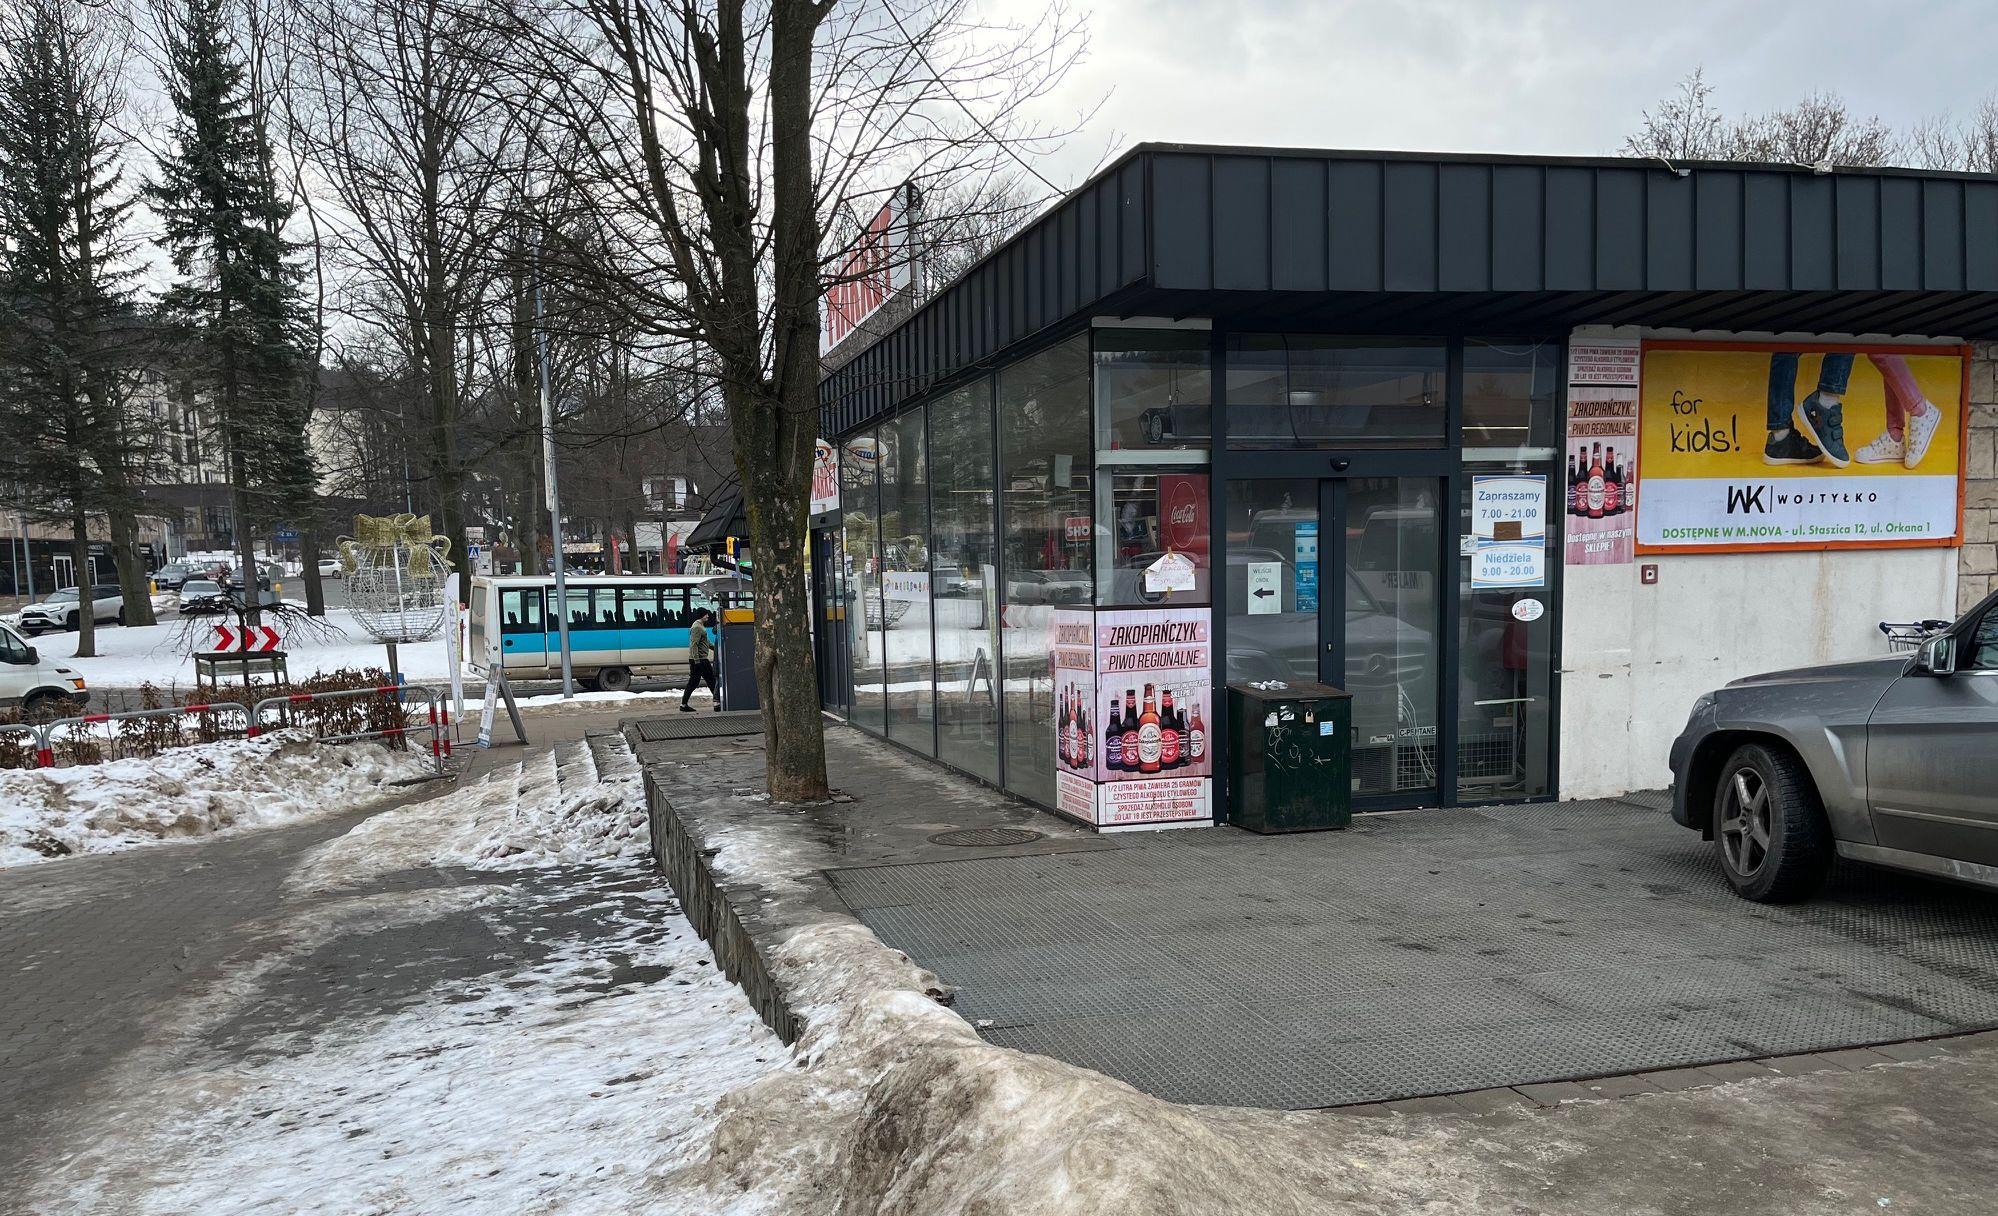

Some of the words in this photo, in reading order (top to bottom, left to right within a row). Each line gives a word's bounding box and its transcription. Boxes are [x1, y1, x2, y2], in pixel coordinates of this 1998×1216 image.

[1574, 398, 1632, 416] ZAKOPIAŃCZYK
[1670, 390, 1702, 414] for
[1572, 423, 1590, 434] PIWO
[1591, 422, 1632, 434] REGIONALNE
[1670, 414, 1740, 452] kids!
[1478, 491, 1540, 503] Zapraszamy
[1778, 493, 1877, 504] WOJTYŁKO
[1482, 510, 1501, 518] 7.00
[1511, 509, 1537, 518] 21.00
[1662, 528, 1719, 540] DOSTĘPNE
[1722, 528, 1733, 536] W
[1736, 526, 1782, 536] M.NOVA
[1792, 525, 1805, 535] ul.
[1809, 524, 1850, 535] Staszica
[1855, 524, 1867, 535] 12,
[1871, 523, 1882, 533] ul.
[1886, 522, 1922, 532] Orkana
[1486, 553, 1531, 563] Niedziela
[1482, 567, 1501, 576] 9.00
[1510, 566, 1534, 576] 20.00
[1110, 620, 1197, 645] ZAKOPIAŃCZYK
[1109, 654, 1135, 670] PIWO
[1137, 650, 1200, 669] REGIONALNE
[1108, 784, 1117, 792] 1/2
[1148, 781, 1170, 789] ZAWIERA
[1113, 792, 1139, 800] CZYSTEGO
[1172, 801, 1193, 809] OSOBOM
[1123, 812, 1132, 820] LAT
[1141, 811, 1152, 819] JEST
